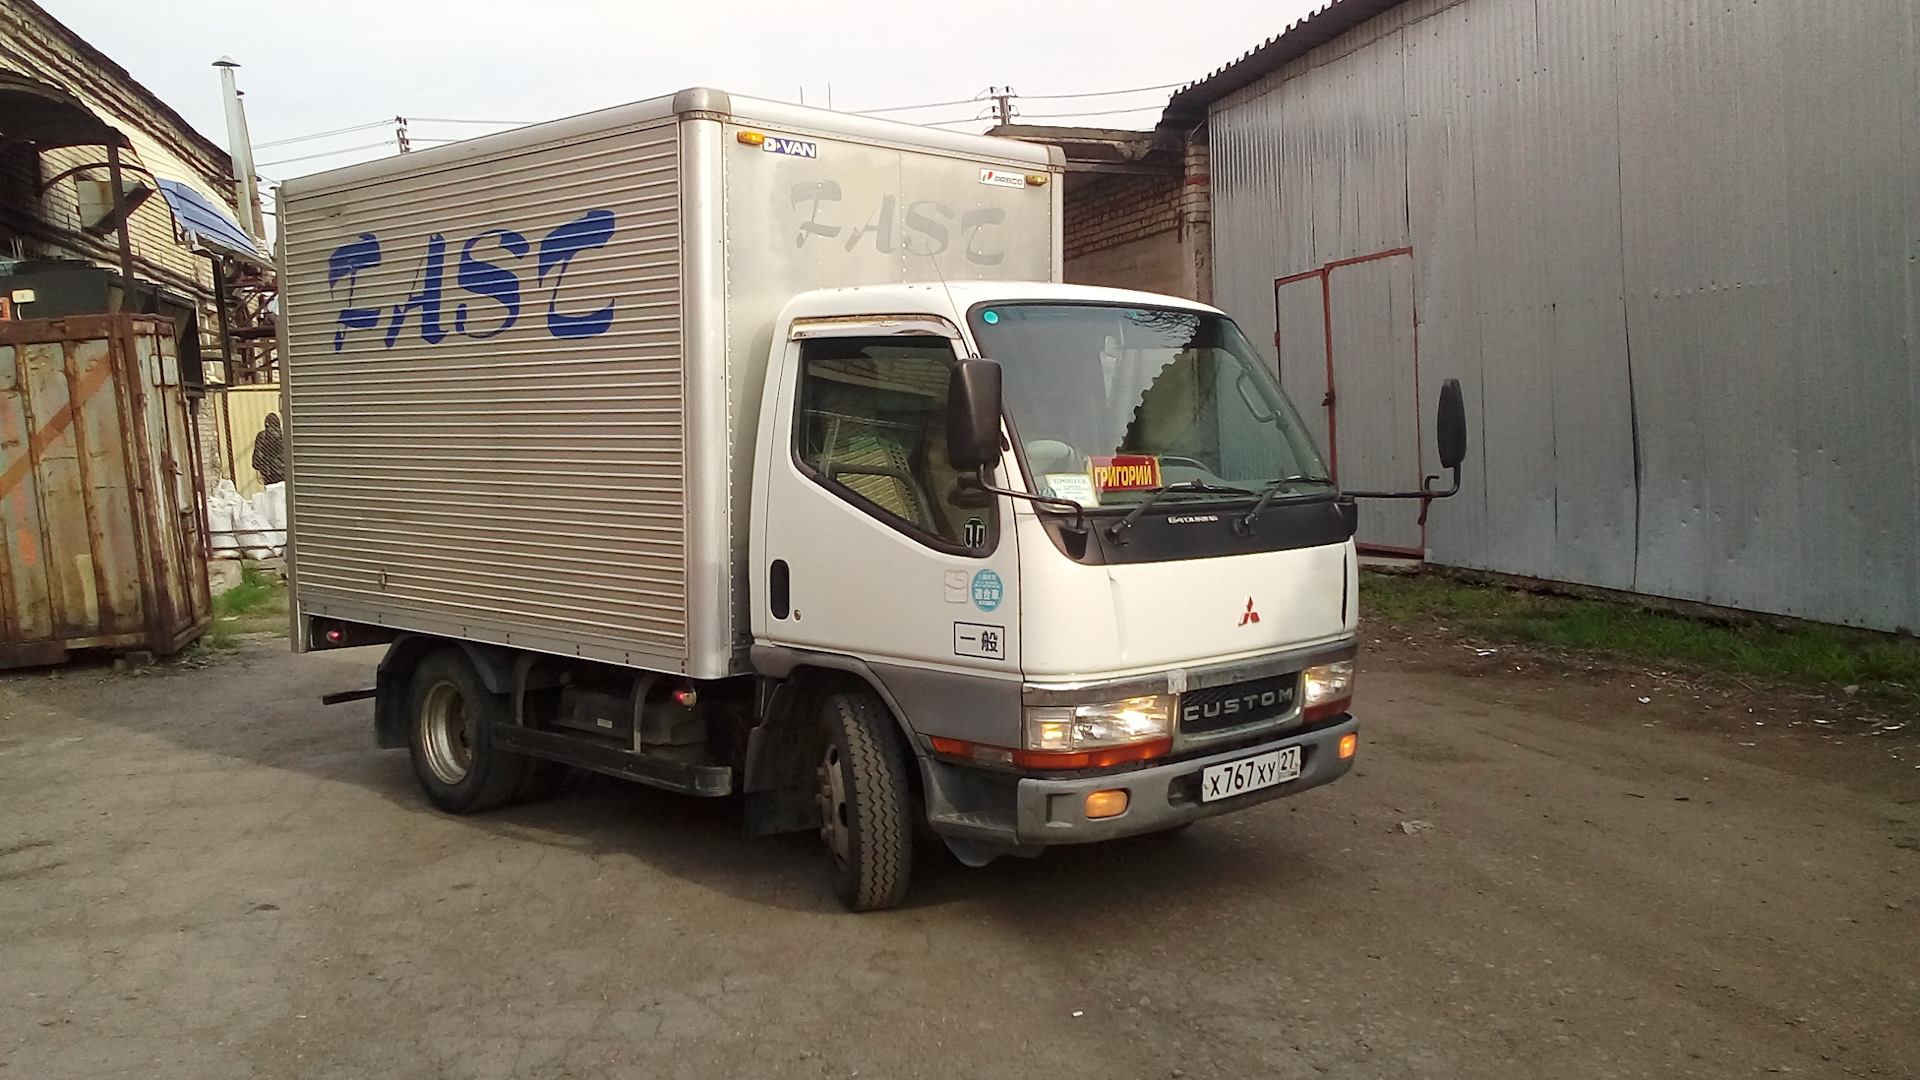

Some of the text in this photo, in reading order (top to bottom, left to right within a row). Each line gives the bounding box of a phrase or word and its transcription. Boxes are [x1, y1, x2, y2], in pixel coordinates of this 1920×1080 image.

[1094, 461, 1152, 488] ГРИГОРИЙ
[960, 630, 998, 653] 一般
[1183, 687, 1293, 722] CUSTOM
[1281, 749, 1295, 771] 27
